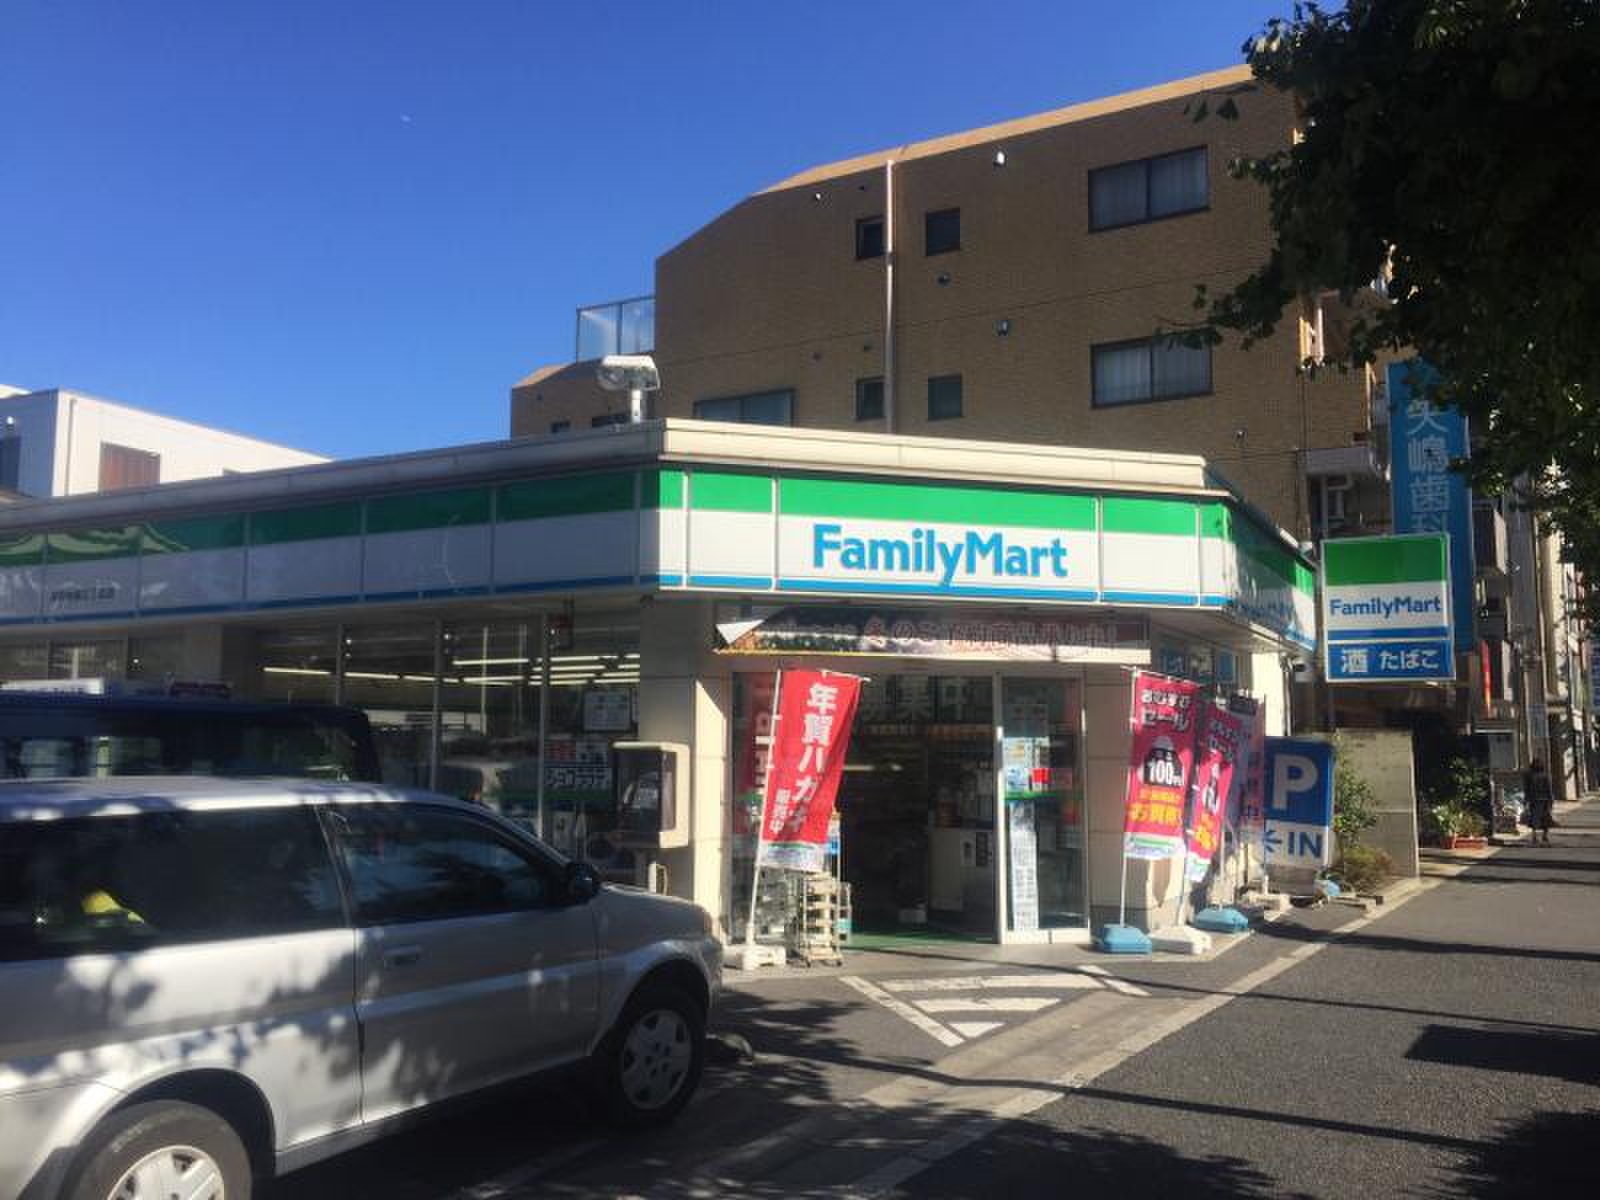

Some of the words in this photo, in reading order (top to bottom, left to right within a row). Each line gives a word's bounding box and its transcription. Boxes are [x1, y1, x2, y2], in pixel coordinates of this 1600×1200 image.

[813, 524, 1068, 587] FamilyMart
[1330, 595, 1442, 621] FamilyMart
[1340, 648, 1368, 675] 酒
[1379, 650, 1440, 672] たばこ
[1273, 754, 1320, 810] P
[1287, 832, 1322, 860] IN
